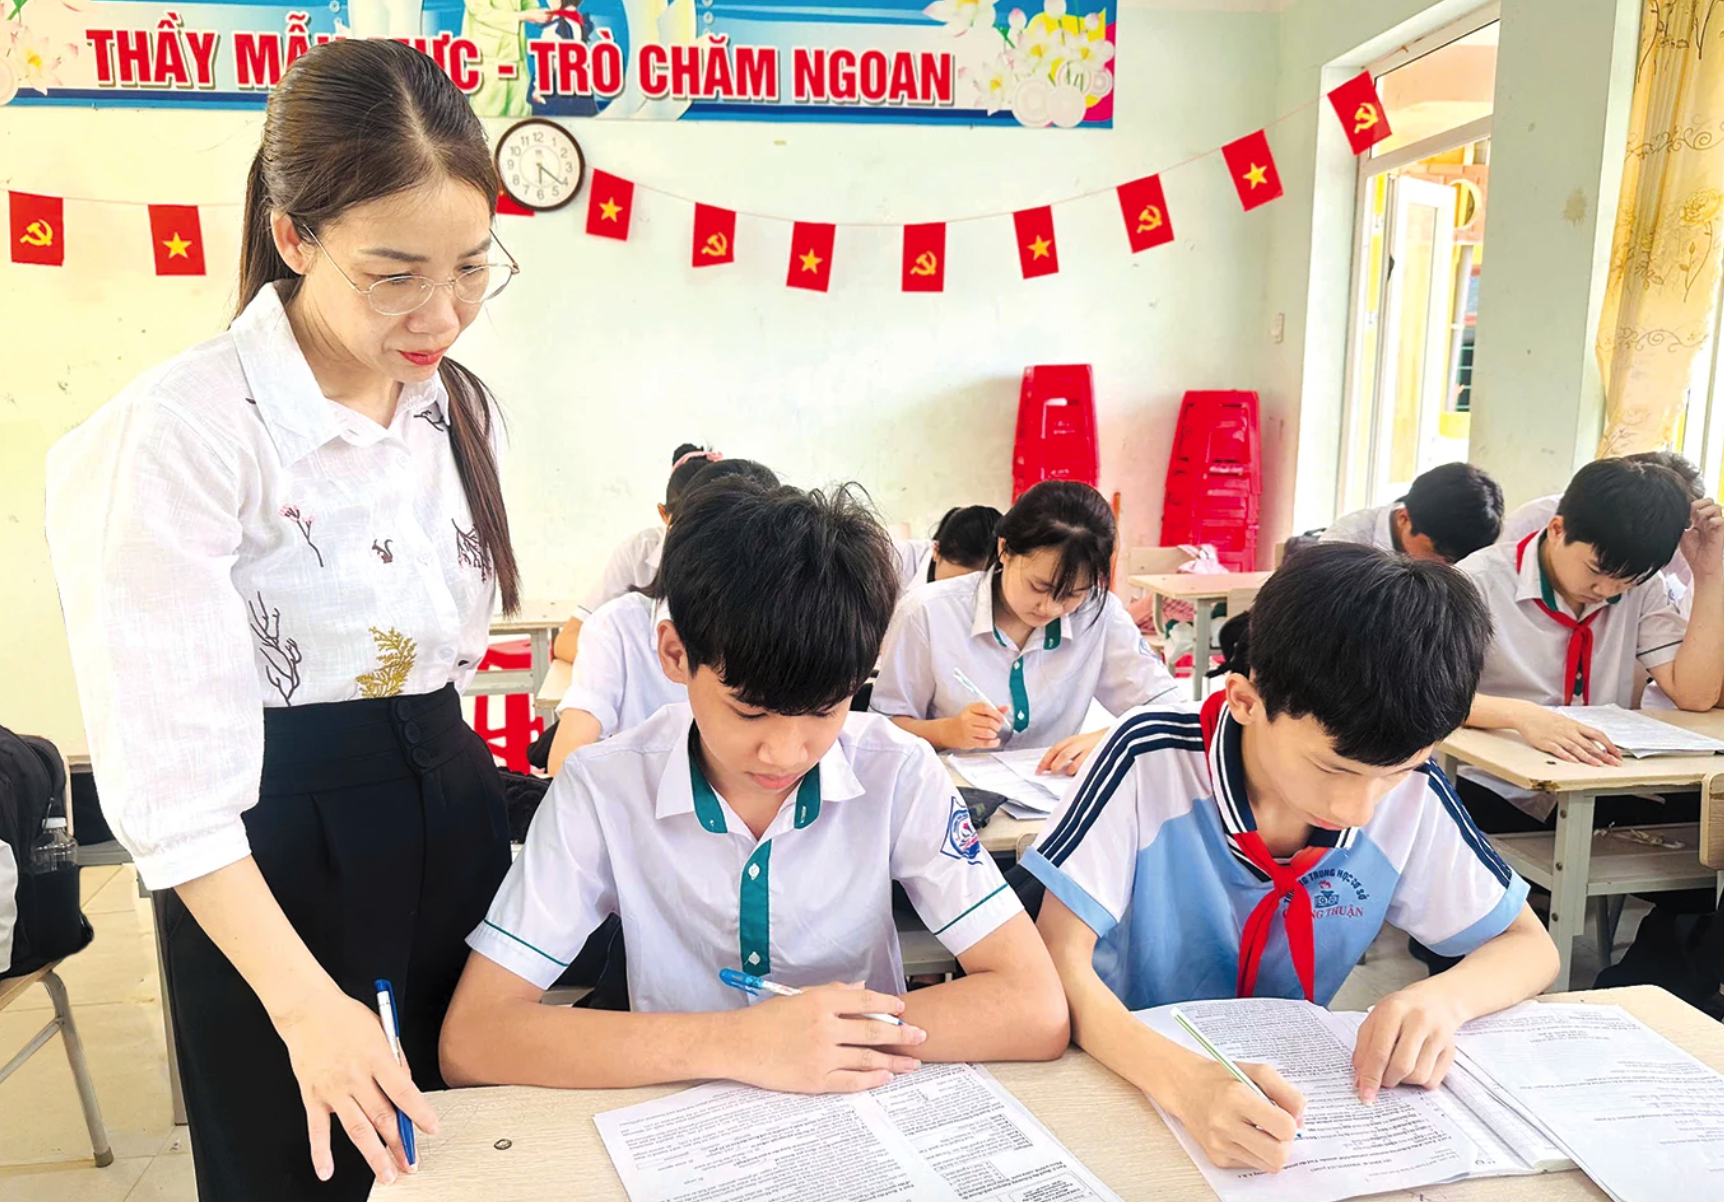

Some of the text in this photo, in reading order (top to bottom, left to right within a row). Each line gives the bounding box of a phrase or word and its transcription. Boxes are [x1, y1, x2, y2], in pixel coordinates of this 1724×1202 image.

[85, 12, 217, 84] THẦY
[234, 13, 347, 86] MẪ
[530, 30, 622, 94] TRÒ
[638, 34, 777, 99] CHĂM
[793, 48, 952, 102] NGOAN
[520, 135, 530, 146] 11
[533, 131, 544, 143] 12
[509, 145, 522, 157] 10
[560, 147, 568, 159] 2
[506, 159, 514, 170] 9
[565, 161, 573, 173] 3
[512, 174, 520, 186] 8
[523, 184, 530, 195] 7
[537, 188, 545, 201] 6
[552, 185, 560, 197] 5
